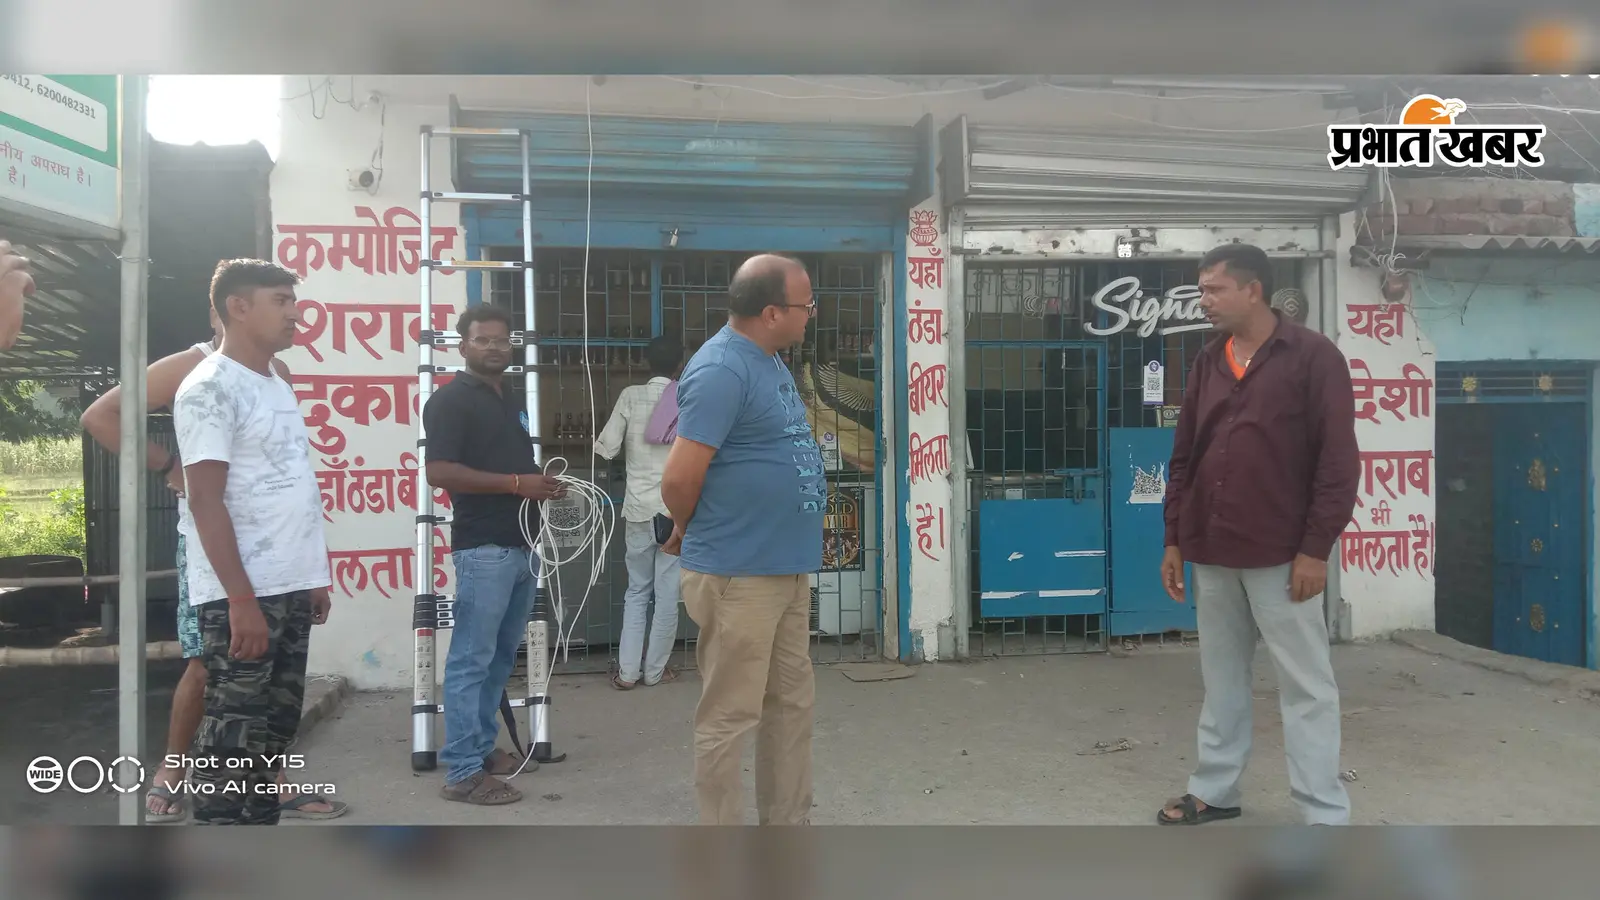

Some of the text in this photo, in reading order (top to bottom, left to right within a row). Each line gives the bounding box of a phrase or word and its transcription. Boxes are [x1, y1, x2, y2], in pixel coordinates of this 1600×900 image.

[37, 84, 96, 119] 6200482331
[31, 154, 70, 178] अपराध
[908, 247, 945, 290] यहाँ
[908, 299, 943, 345] ठंडा
[1083, 276, 1212, 338] Signa
[291, 374, 457, 455] दुका
[908, 362, 948, 416] बीयर
[1350, 359, 1433, 425] देशी
[347, 455, 396, 514] ठंडा
[909, 432, 949, 485] मिलता
[1370, 500, 1392, 527] भी
